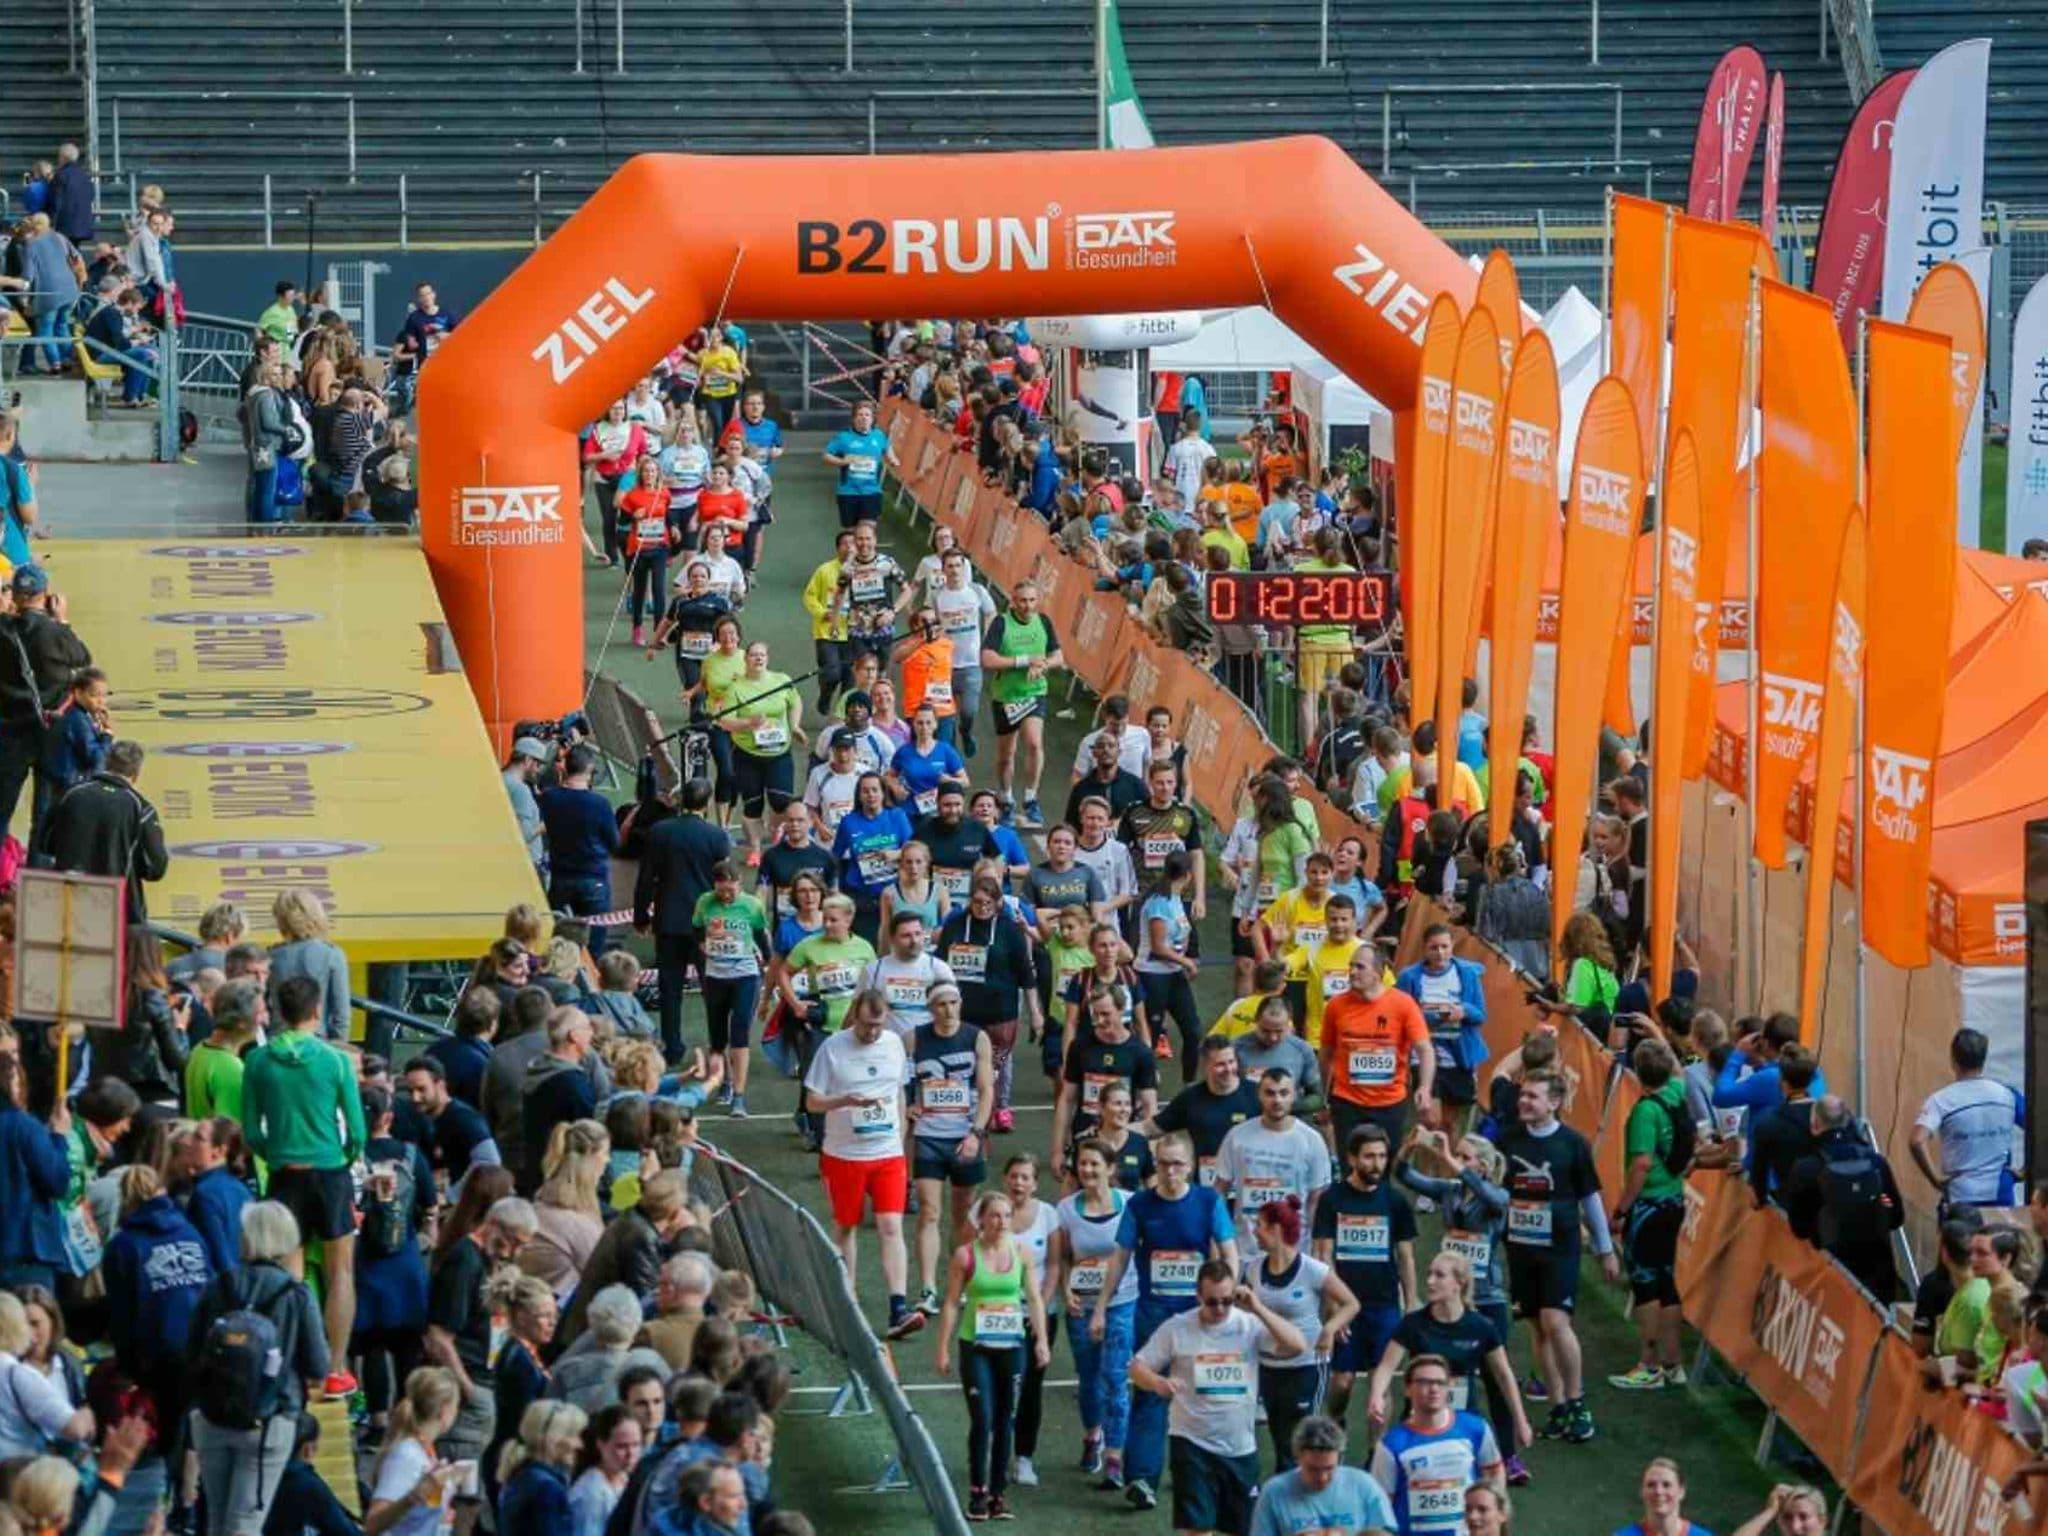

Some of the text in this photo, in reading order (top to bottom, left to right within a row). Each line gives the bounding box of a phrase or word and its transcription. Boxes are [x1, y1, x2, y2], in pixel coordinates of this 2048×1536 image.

[1076, 211, 1177, 248] DAK
[797, 216, 1048, 275] B2RUN
[1075, 247, 1178, 270] Gesundheit
[531, 277, 656, 385] ZIEL
[1580, 463, 1632, 513] DAK
[461, 485, 562, 522] DAK
[461, 523, 566, 545] Gesundheit
[1341, 1228, 1384, 1243] 10917
[1159, 1264, 1196, 1279] 2748
[1205, 1366, 1243, 1381] 1070
[1418, 1493, 1459, 1510] 2648
